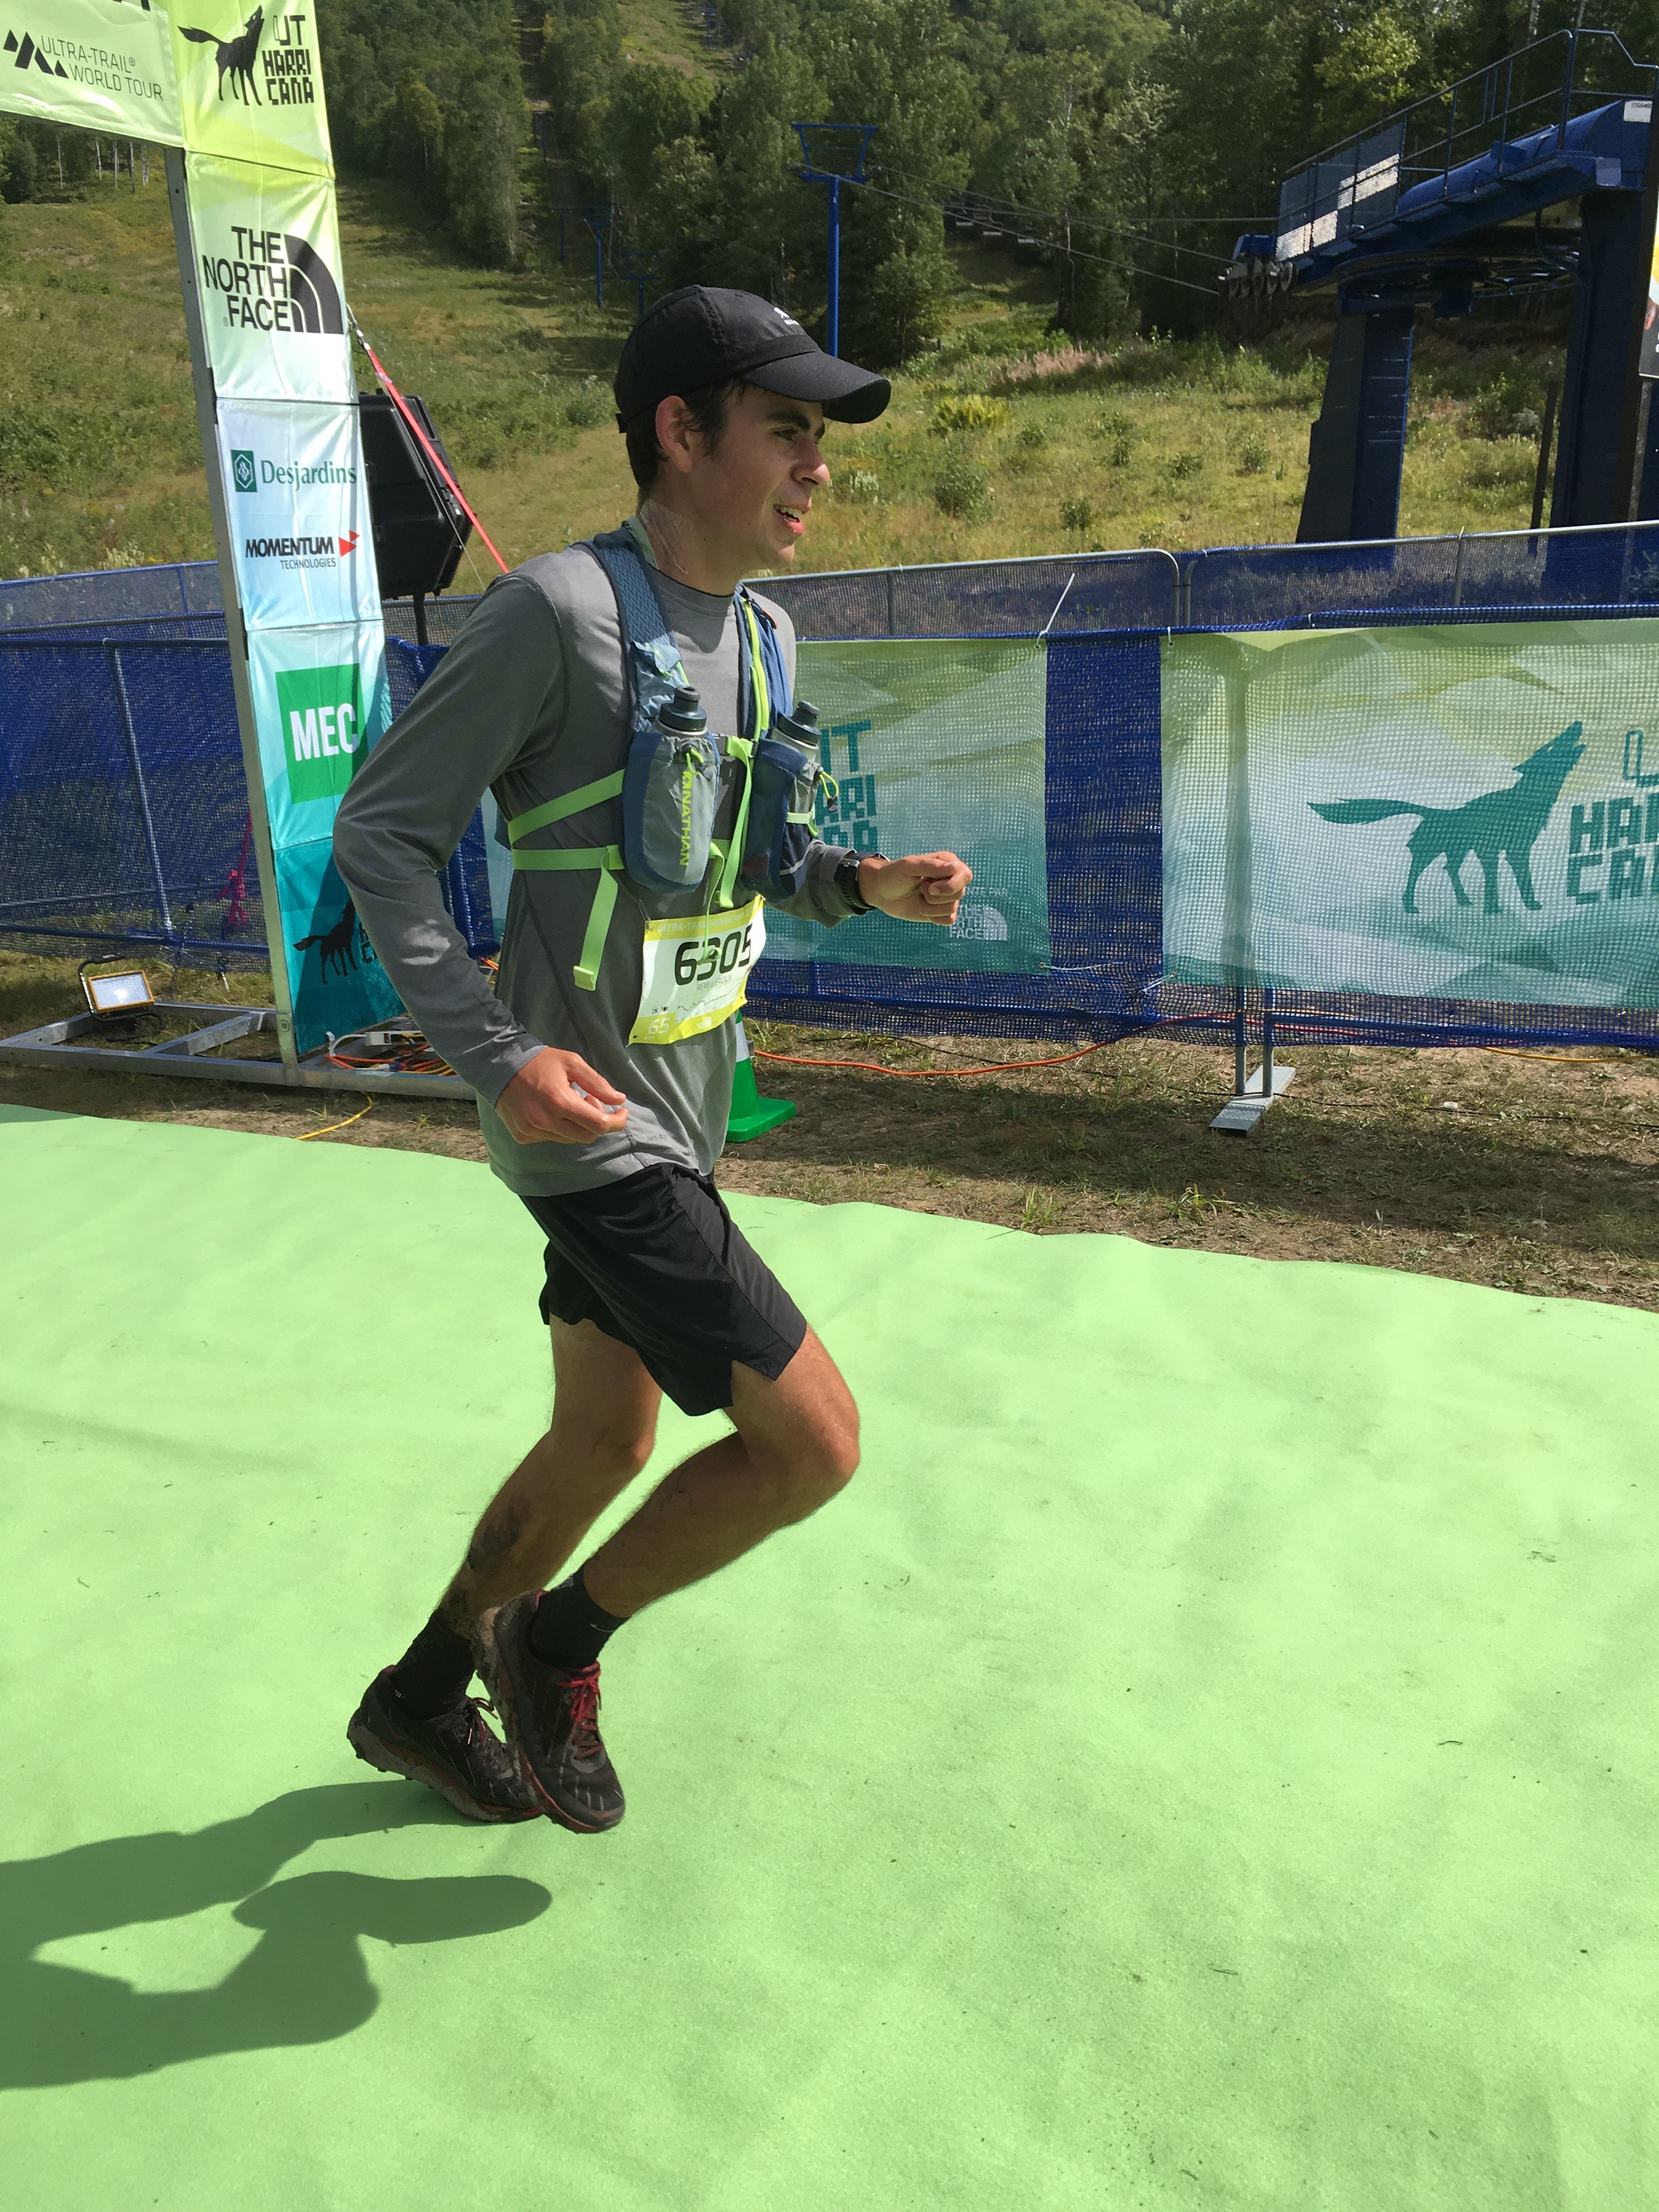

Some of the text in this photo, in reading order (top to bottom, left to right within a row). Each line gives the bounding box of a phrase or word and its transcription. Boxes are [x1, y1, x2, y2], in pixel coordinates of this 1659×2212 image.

[273, 15, 306, 46] UT
[262, 49, 312, 77] HARRI
[69, 63, 163, 101] WORLD TOUR
[266, 77, 314, 105] CANA
[231, 225, 285, 264] THE
[202, 255, 287, 298] NORTH
[226, 294, 291, 332] FACE
[261, 460, 357, 491] Desjardins
[245, 537, 335, 558] MOMENTUM
[280, 557, 336, 570] TECHNOLOGIES
[289, 703, 358, 762] MEC
[679, 790, 692, 867] NATHAN
[949, 928, 984, 940] FACE
[674, 923, 752, 986] 6305
[711, 974, 733, 987] LEROUX
[648, 1017, 669, 1034] 65
